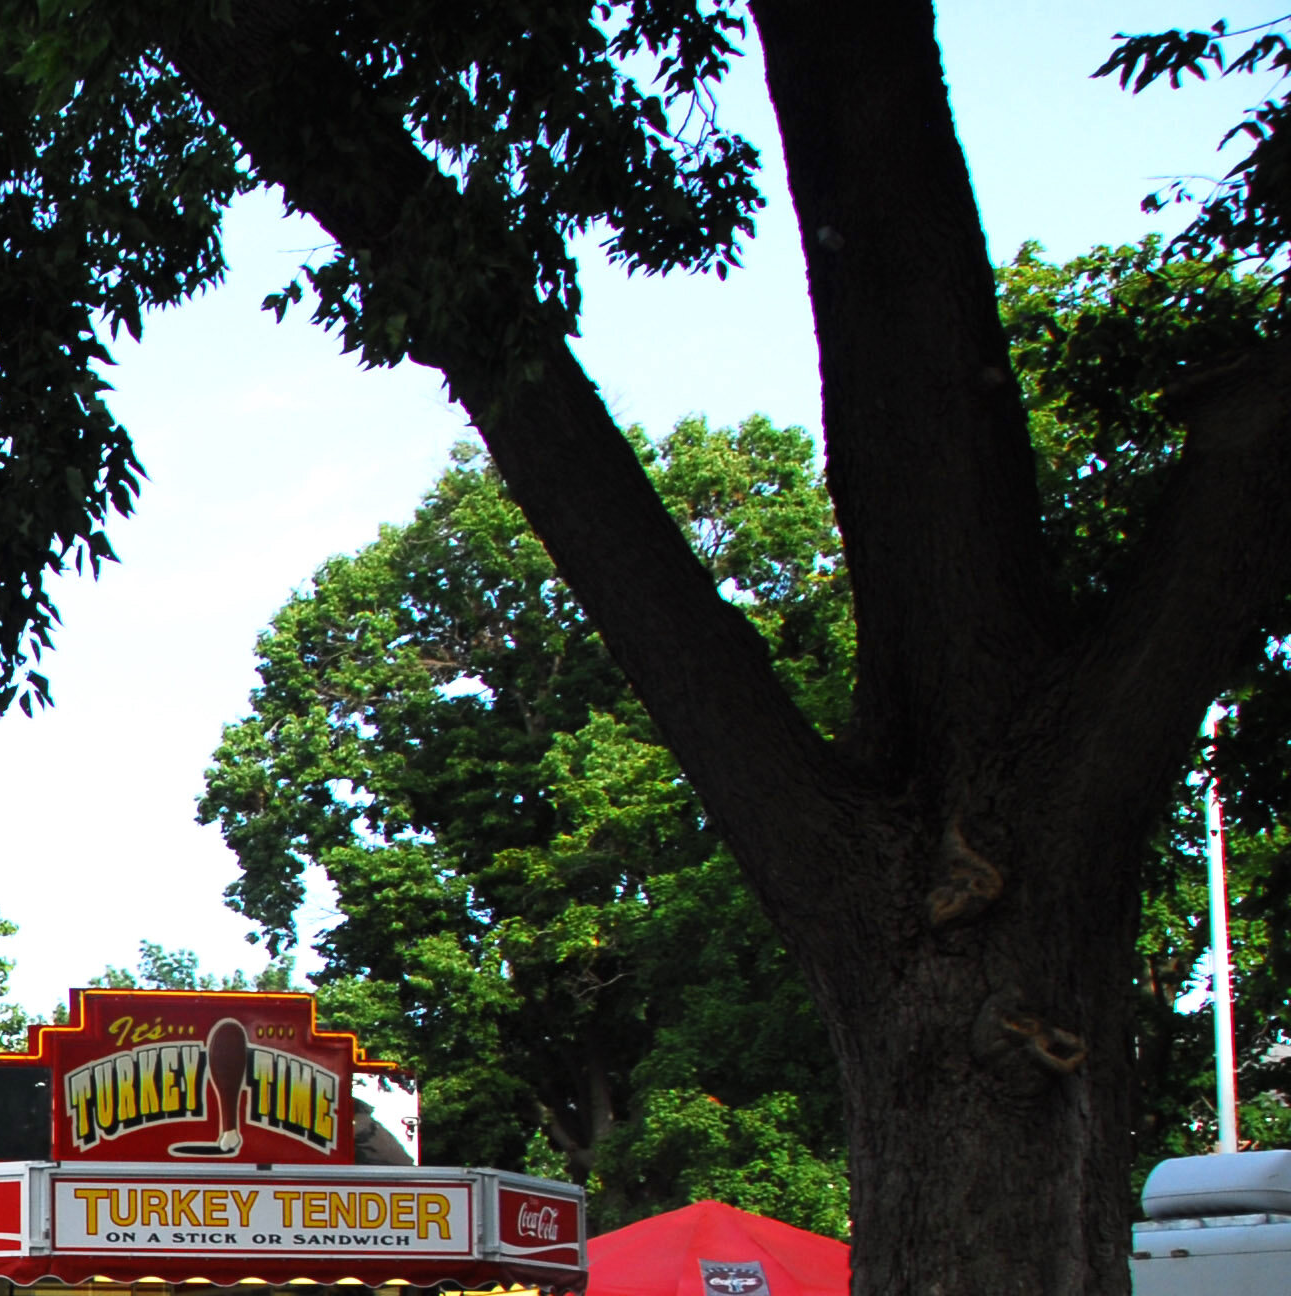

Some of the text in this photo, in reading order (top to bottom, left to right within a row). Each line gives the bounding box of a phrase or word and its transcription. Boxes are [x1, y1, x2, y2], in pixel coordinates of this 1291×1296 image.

[69, 1045, 336, 1146] TURKEY TIME
[74, 1188, 452, 1240] TURKEY TENDER
[518, 1202, 559, 1241] Coca-Cola
[106, 1232, 410, 1246] ON A STICK OR SANDWICH
